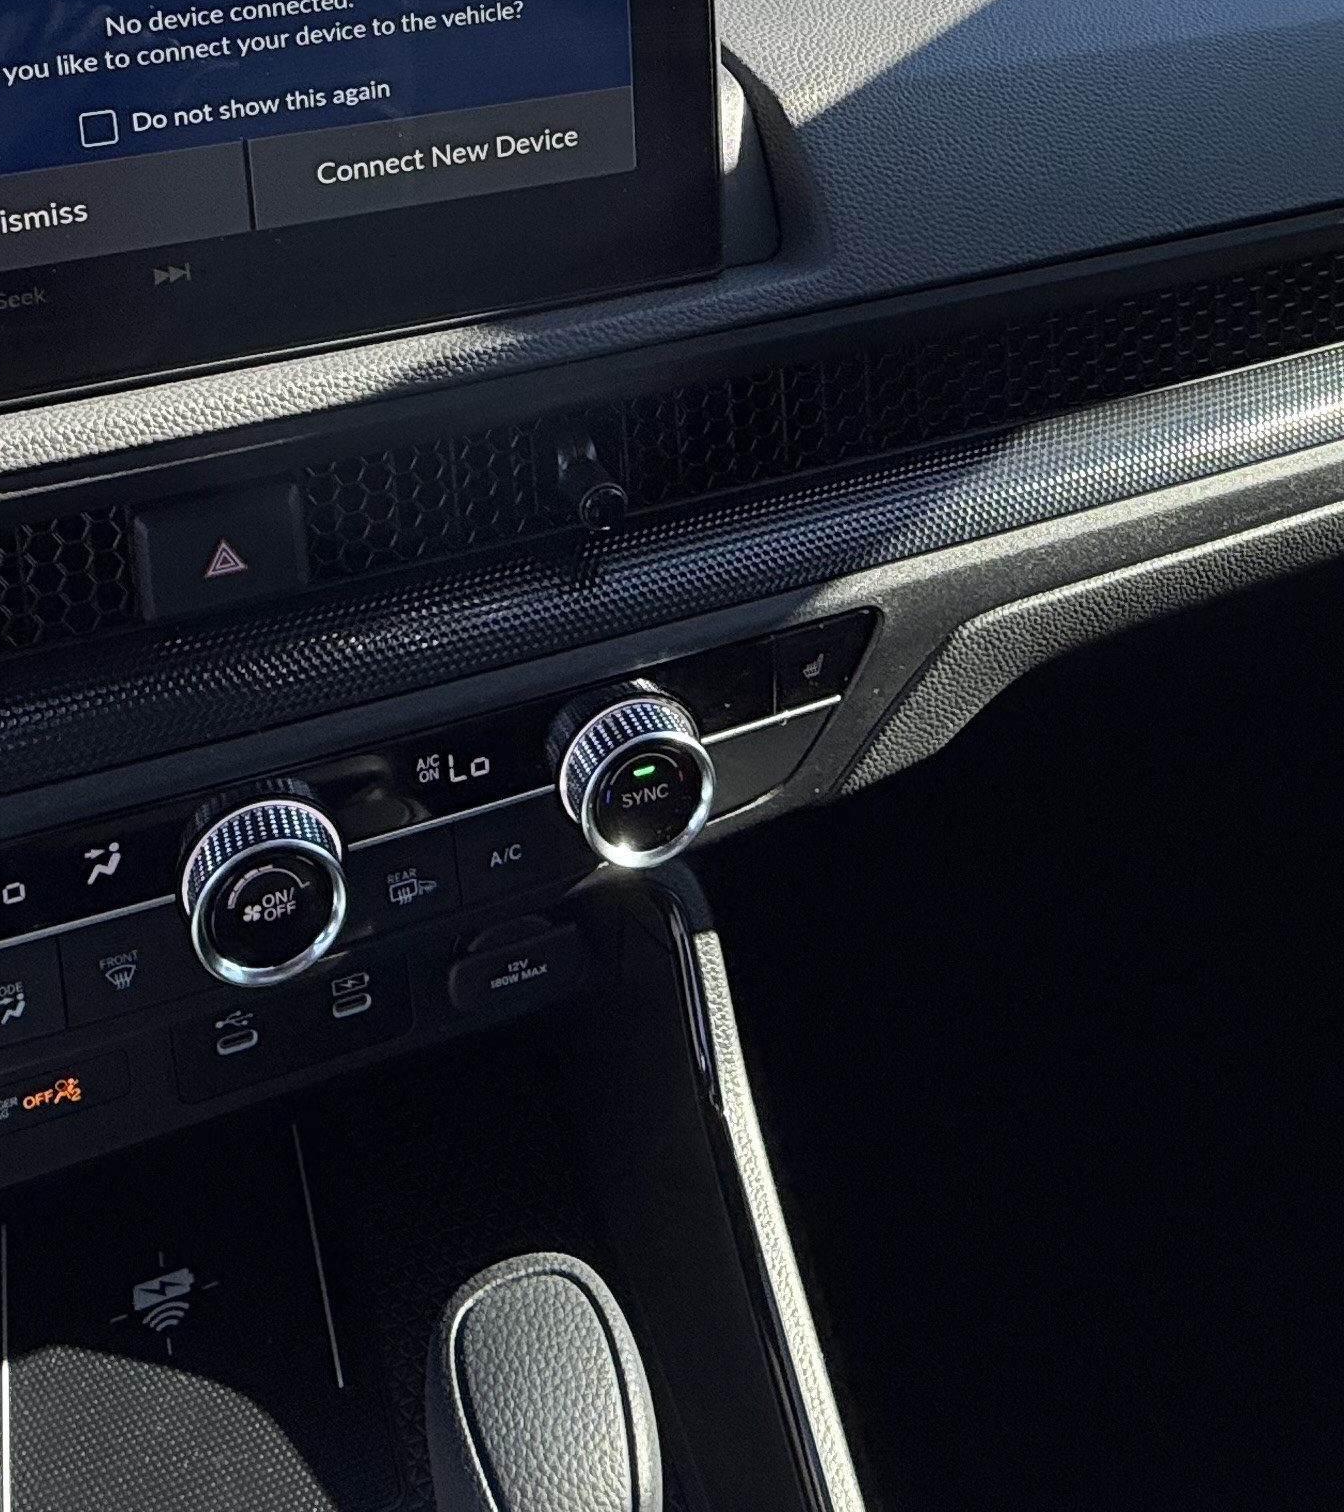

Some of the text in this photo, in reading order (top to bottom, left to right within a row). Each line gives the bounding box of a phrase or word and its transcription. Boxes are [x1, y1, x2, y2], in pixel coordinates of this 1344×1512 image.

[106, 16, 141, 37] No
[148, 6, 224, 34] device
[2, 62, 50, 87] you
[56, 54, 98, 76] like
[104, 51, 130, 71] to
[137, 37, 231, 67] connect
[237, 32, 289, 58] your
[295, 20, 367, 47] device
[372, 17, 395, 36] to
[401, 12, 437, 34] the
[441, 0, 524, 28] vehicle?
[132, 80, 391, 132] Do not show this again
[317, 128, 578, 185] Connect New Device
[416, 754, 490, 782] A/C Lo
[418, 768, 440, 783] ON
[621, 783, 669, 809] SYNC
[490, 844, 522, 868] A/C
[387, 868, 417, 884] REAR
[262, 887, 295, 908] ON/
[264, 900, 297, 921] OFF
[99, 949, 139, 970] FRONT
[508, 959, 528, 972] 12V
[491, 963, 547, 989] 180W MAX
[22, 1090, 54, 1110] OFF
